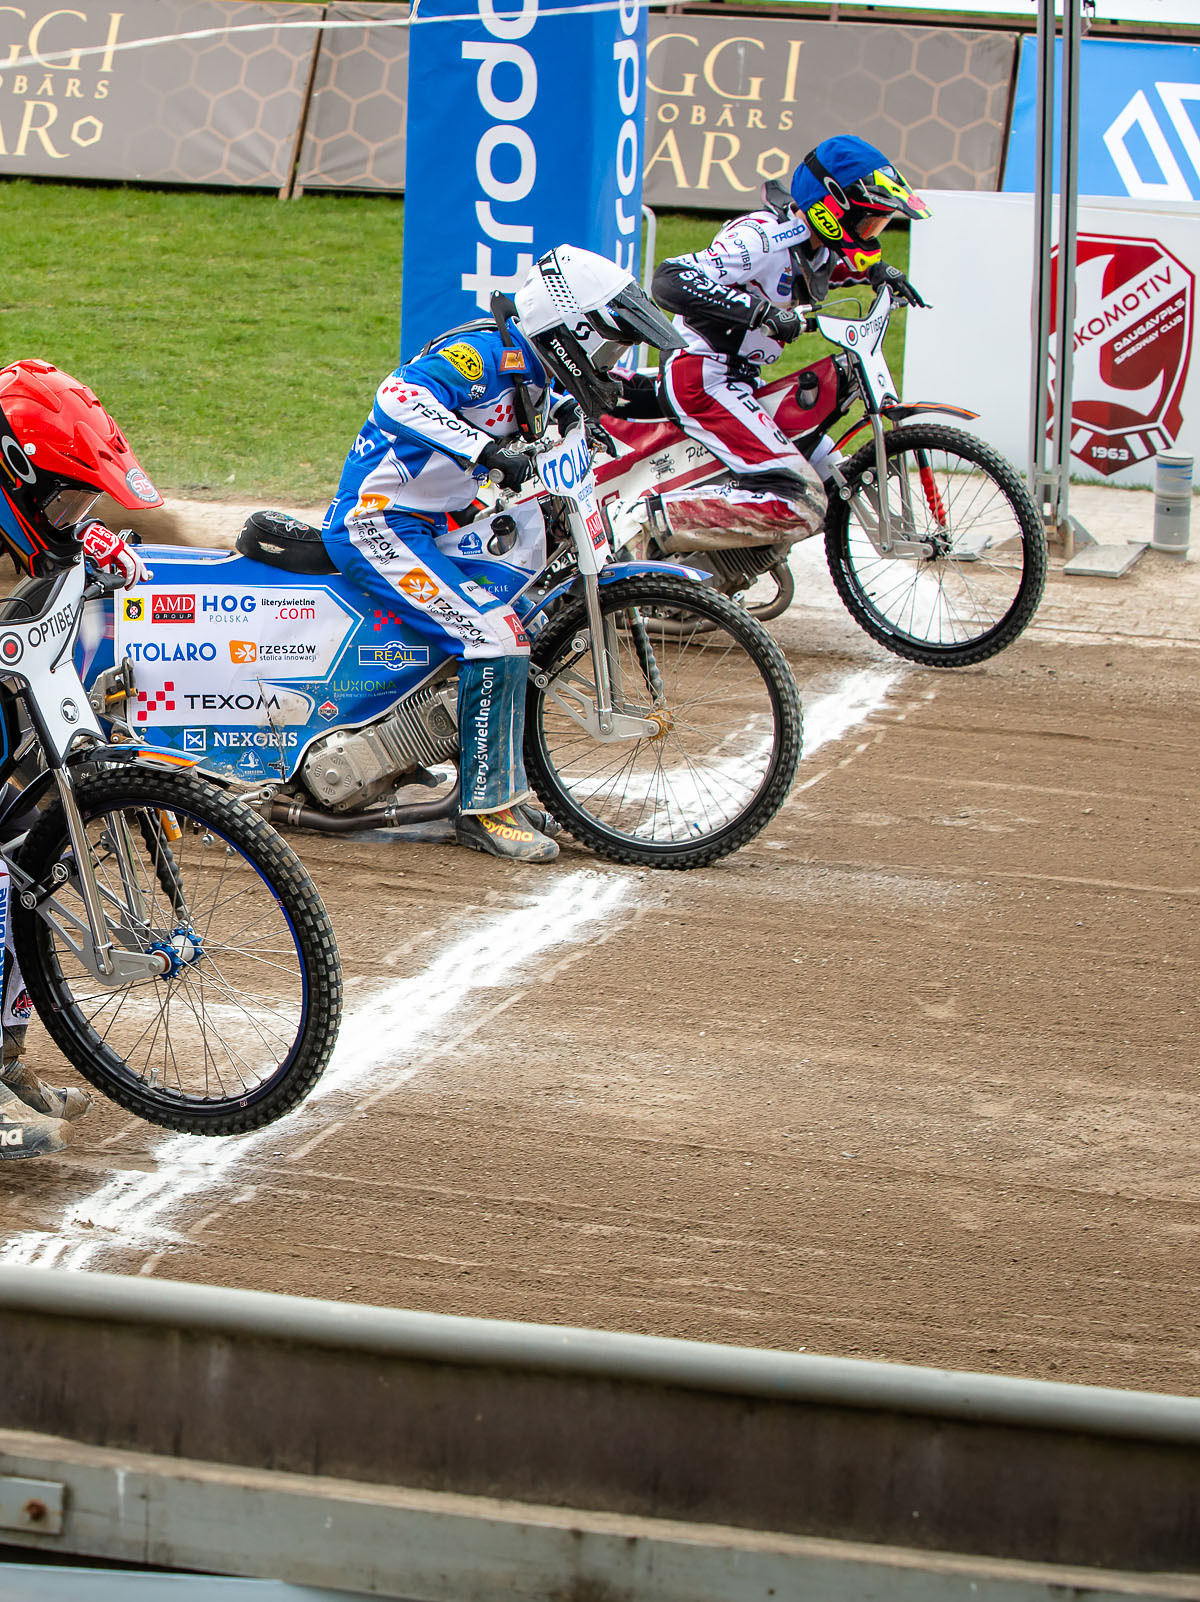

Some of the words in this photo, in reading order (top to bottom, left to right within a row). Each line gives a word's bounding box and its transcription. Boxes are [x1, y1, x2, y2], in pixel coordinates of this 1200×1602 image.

[645, 33, 805, 102] GGI
[656, 103, 794, 131] OBĀRS
[642, 128, 757, 193] AR
[814, 208, 839, 235] Arai
[771, 224, 806, 243] TRODO
[707, 248, 728, 279] OFIA
[1073, 265, 1173, 353] KOMOTIV
[1112, 297, 1186, 352] DAUGAVPILS
[1160, 314, 1184, 335] CLUB
[550, 338, 583, 377] STOLARO
[412, 401, 480, 441] TEXOM
[1091, 446, 1130, 461] 1963
[542, 438, 591, 490] STOLAR
[153, 596, 195, 612] AMD
[202, 595, 257, 613] HOG
[274, 608, 316, 620] .com
[27, 603, 74, 648] OPTIBET
[209, 614, 249, 623] POLSKA
[125, 642, 217, 662] STOLARO
[259, 643, 317, 655] rzeszów
[284, 655, 317, 663] innowacji
[373, 650, 417, 662] REALL
[333, 680, 398, 692] LUXIONA
[183, 694, 281, 711] TEXOM
[213, 731, 299, 748] NEXORIS
